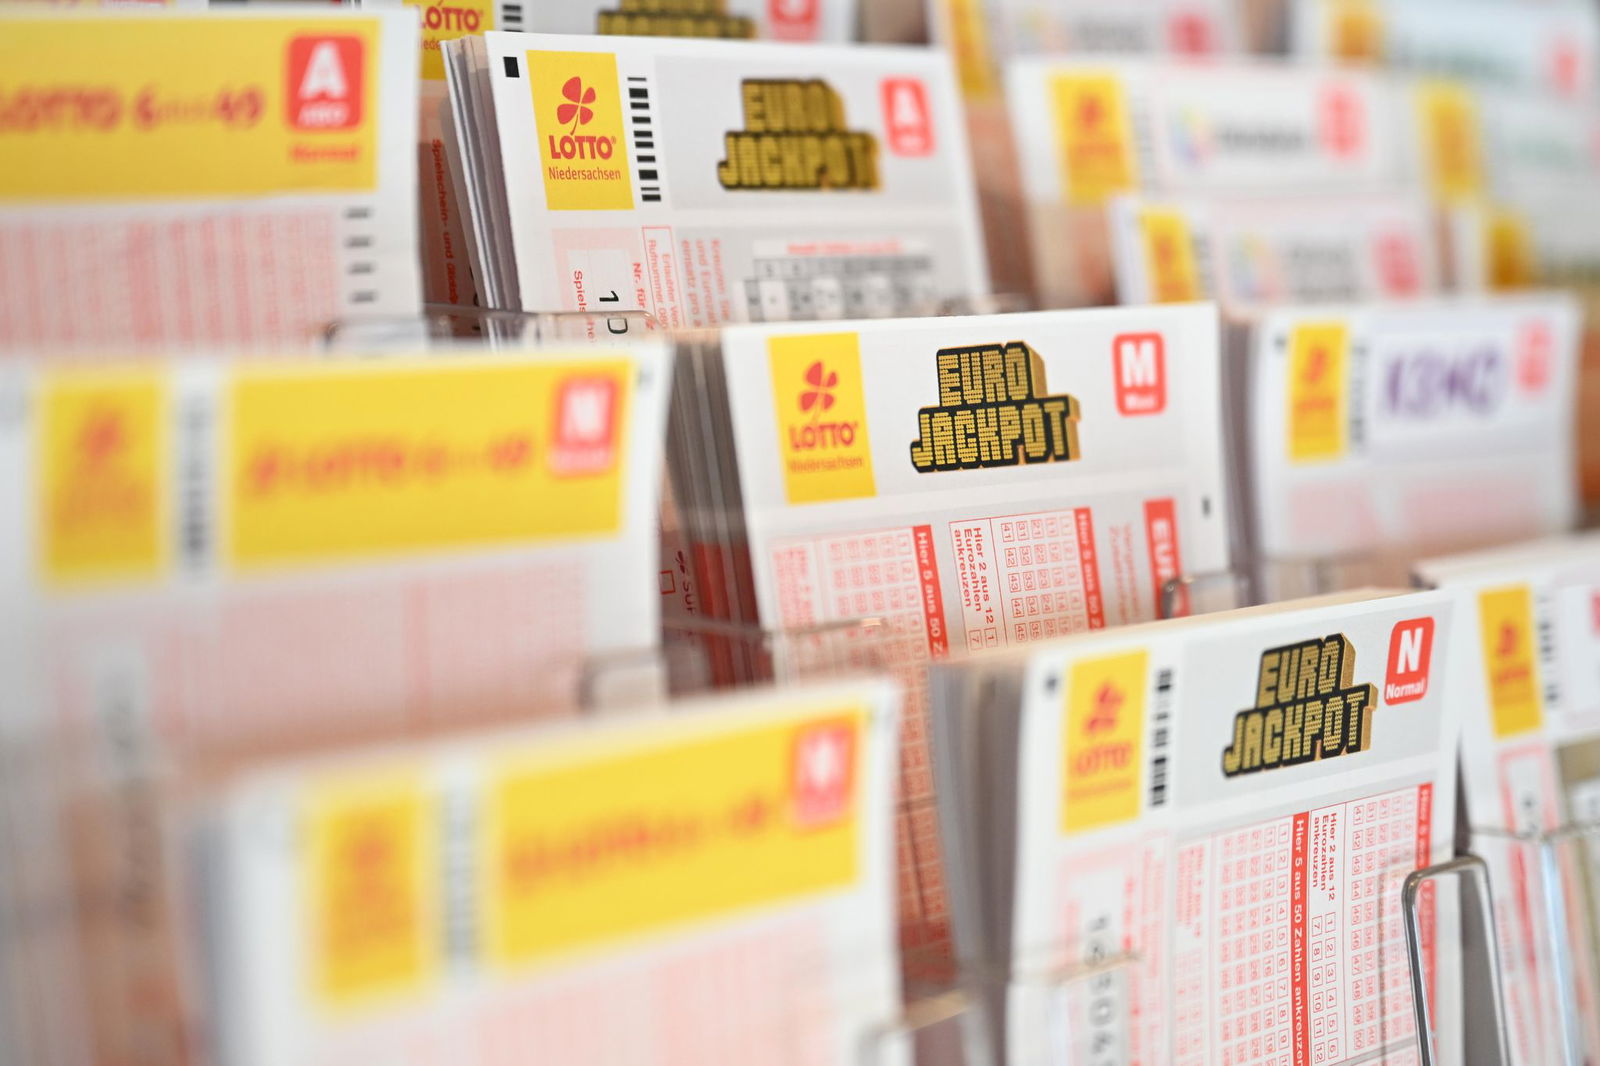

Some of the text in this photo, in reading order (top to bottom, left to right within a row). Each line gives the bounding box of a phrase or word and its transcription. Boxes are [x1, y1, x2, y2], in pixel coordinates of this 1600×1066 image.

[420, 5, 479, 31] OTTO
[548, 166, 621, 181] Niedersachsen
[633, 262, 646, 308] Nr. für
[938, 347, 1029, 407] EURO
[1121, 340, 1155, 387] M
[911, 401, 1066, 467] JACKPOT
[917, 532, 930, 566] Hier
[954, 529, 972, 607] ankreuzen
[964, 528, 982, 612] Eurozahlen
[973, 527, 994, 624] Hier 2 aus 12
[1003, 524, 1026, 641] 41 42 43 44 45
[925, 584, 937, 614] aus
[930, 618, 941, 637] 50
[1256, 640, 1341, 708] EURO
[1396, 627, 1423, 675] N
[1386, 679, 1426, 700] Normal
[1223, 691, 1365, 773] JACKPOT
[1295, 820, 1304, 852] Hier
[1329, 812, 1337, 841] Hier
[1329, 844, 1336, 853] 2
[1312, 817, 1320, 888] ankreuzen
[1321, 815, 1329, 891] Eurozahlen
[1294, 872, 1302, 900] aus
[1328, 887, 1336, 901] 12
[1294, 904, 1302, 923] 50
[1294, 927, 1303, 982] Zahlen
[1314, 996, 1322, 1010] 10
[1295, 987, 1304, 1066] ankreuzen
[1316, 1046, 1323, 1061] 12
